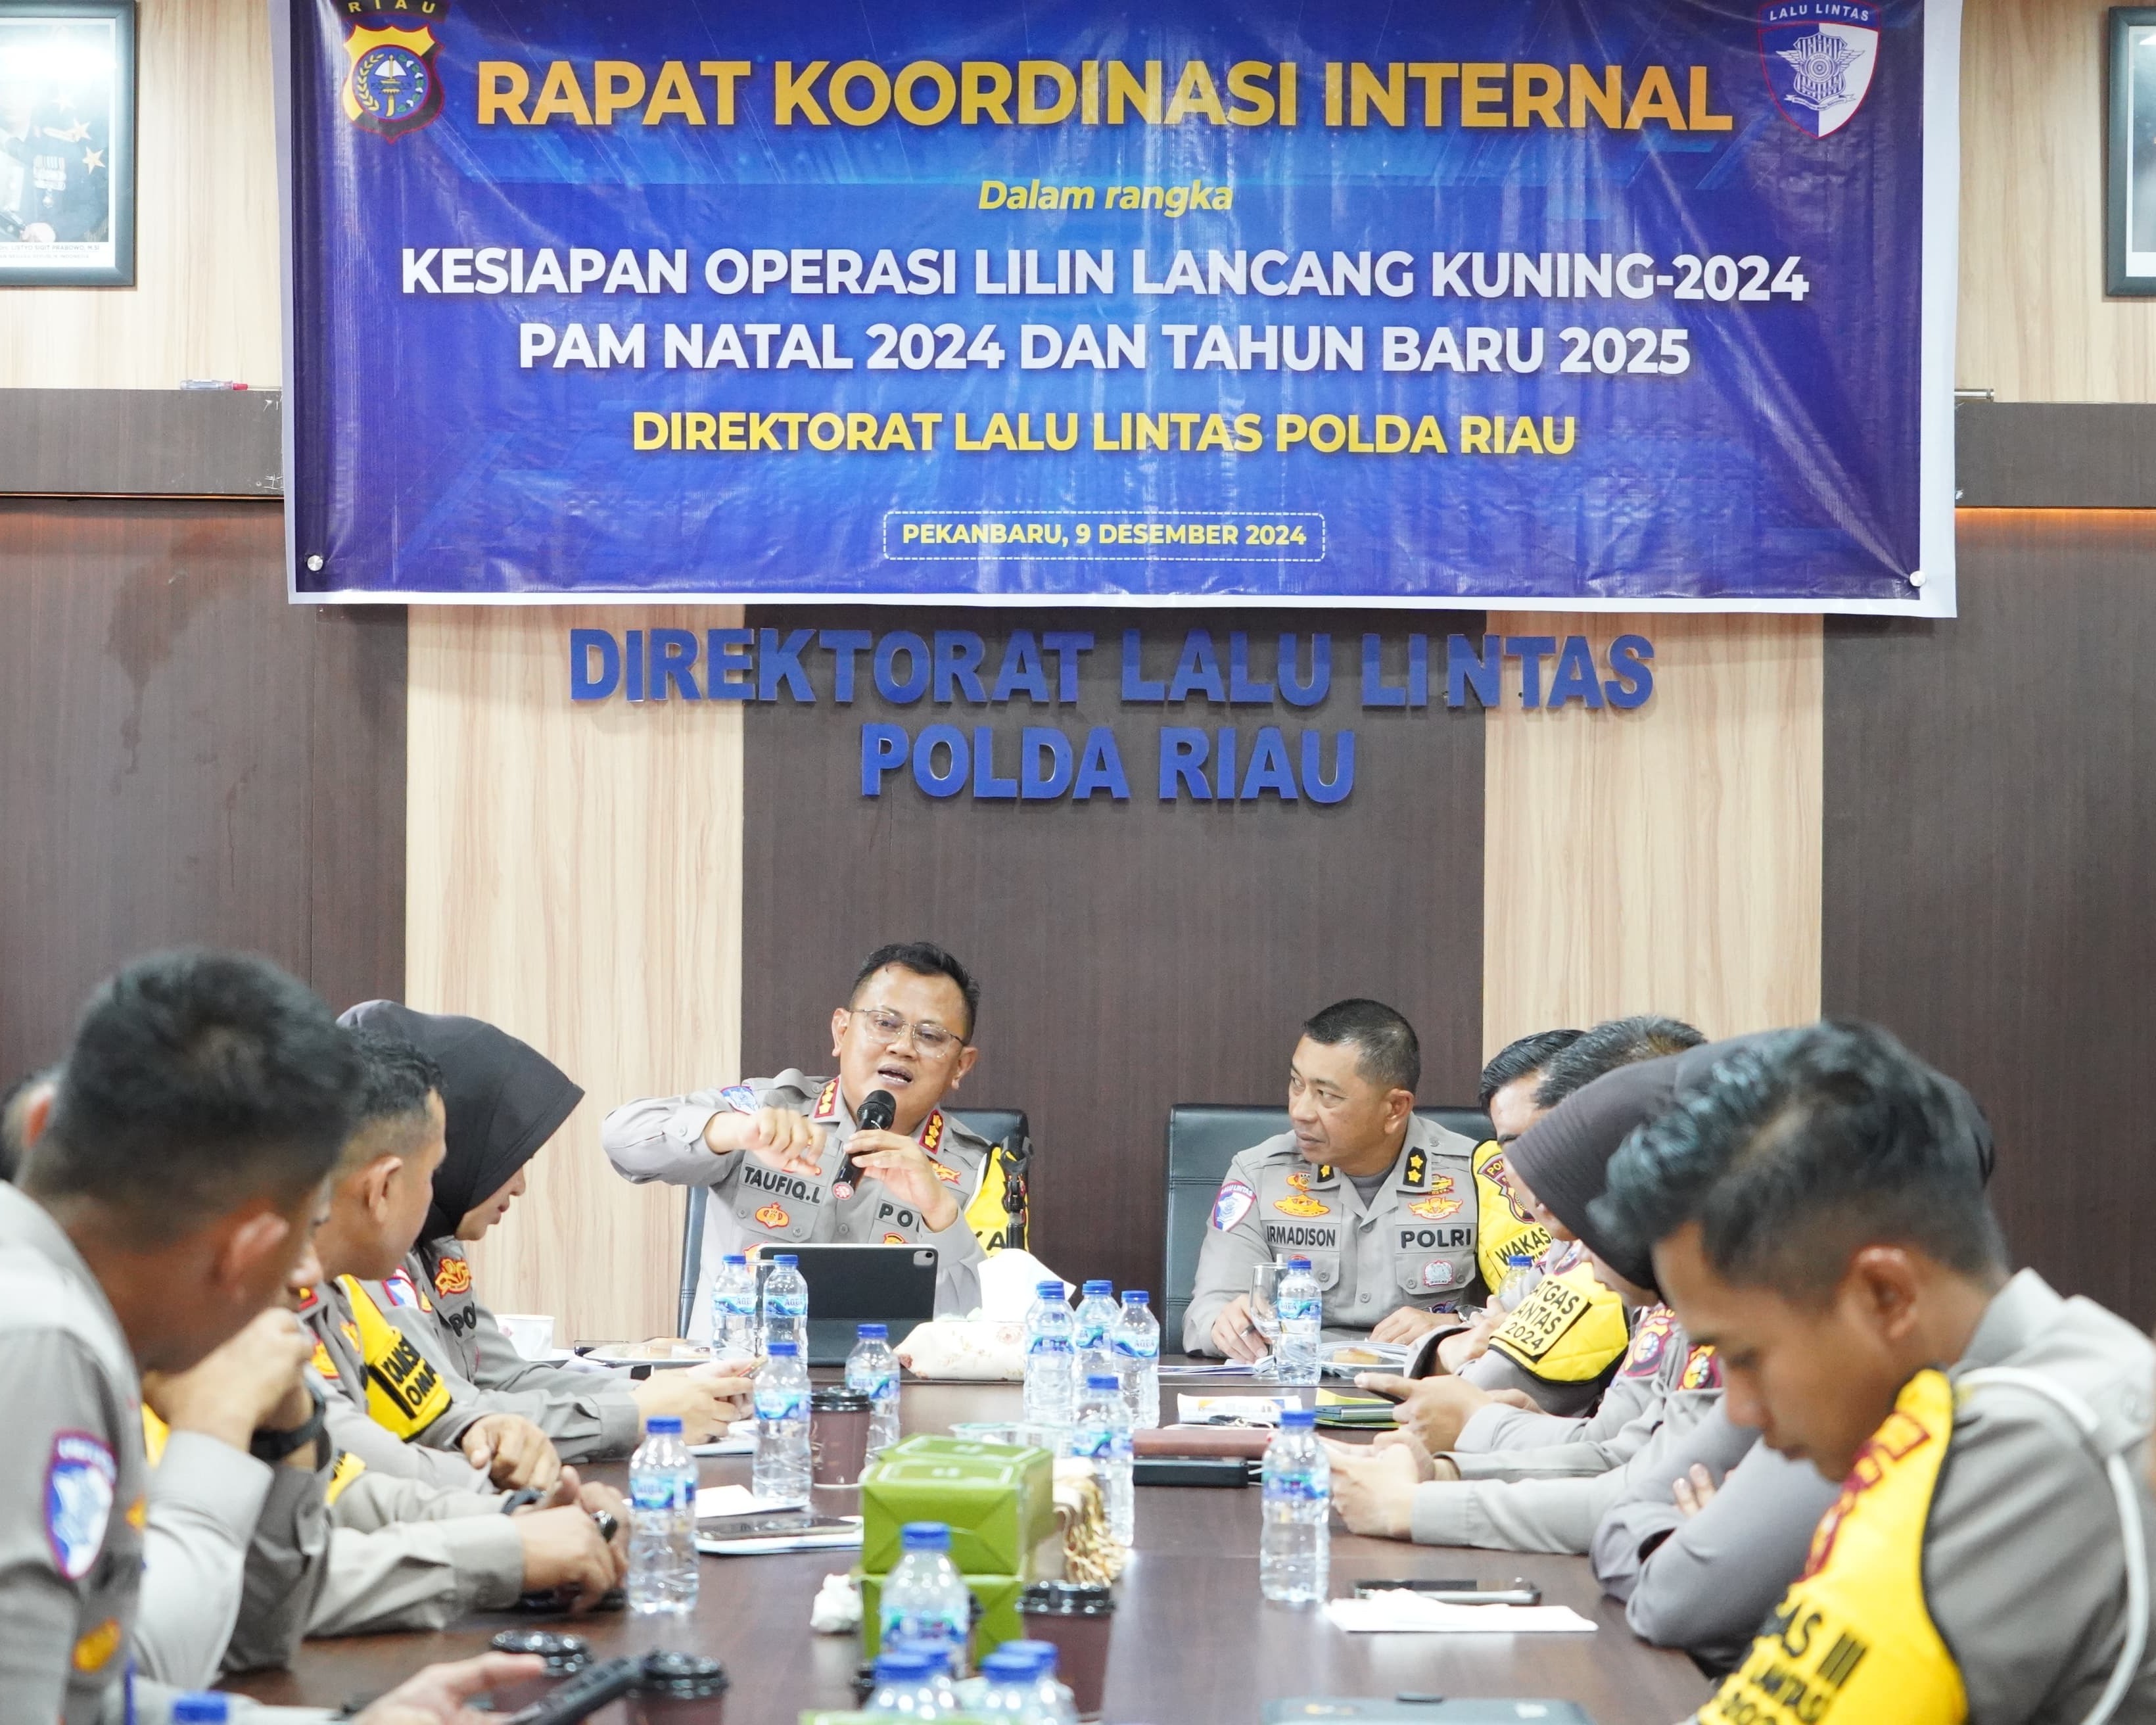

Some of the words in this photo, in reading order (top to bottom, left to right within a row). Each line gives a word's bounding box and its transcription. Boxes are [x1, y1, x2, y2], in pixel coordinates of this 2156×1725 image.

[348, 0, 436, 13] RIAU
[1769, 5, 1808, 21] LALU
[1816, 4, 1869, 21] LINTAS
[477, 60, 751, 126] RAPAT
[774, 60, 1296, 128] KOORDINASI
[1324, 62, 1733, 131] INTERNAL
[977, 179, 1096, 210] Dalam
[1104, 179, 1234, 218] rangka
[402, 247, 688, 295] KESIAPAN
[705, 248, 956, 295] OPERASI
[975, 249, 1113, 295] LILIN
[1132, 249, 1415, 297] LANCANG
[1431, 252, 1810, 301] KUNING-2024
[520, 323, 645, 368] PAM
[664, 323, 853, 369] NATAL
[866, 323, 1005, 369] 2024
[1020, 323, 1146, 369] DAN
[1161, 324, 1363, 371] TAHUN
[1382, 326, 1544, 373] BARU
[1558, 327, 1691, 375] 2025
[632, 412, 942, 451] DIREKTORAT
[955, 412, 1078, 451] LALU
[1093, 412, 1263, 452] LINTAS
[1277, 414, 1448, 454] POLDA
[1460, 415, 1576, 455] RIAU
[902, 524, 1069, 547] PEKANBARU,
[1075, 523, 1091, 545] 9
[1098, 524, 1238, 546] DESEMBER
[1246, 525, 1307, 546] 2024
[570, 628, 1095, 703] DIREKTORAT
[1121, 628, 1332, 707] LALU
[1361, 633, 1655, 709] LINTAS
[860, 722, 1131, 800] POLDA
[1159, 726, 1356, 804] RIAU
[744, 1166, 820, 1204] TAUFIQ.L
[878, 1202, 920, 1233] PO
[1267, 1225, 1336, 1246] IRMADISON
[1400, 1228, 1472, 1249] POLRI
[1495, 1227, 1554, 1267] WAKAS
[1530, 1280, 1580, 1315] ATGAS
[1505, 1321, 1545, 1350] 2024
[1512, 1300, 1562, 1335] ANTAS
